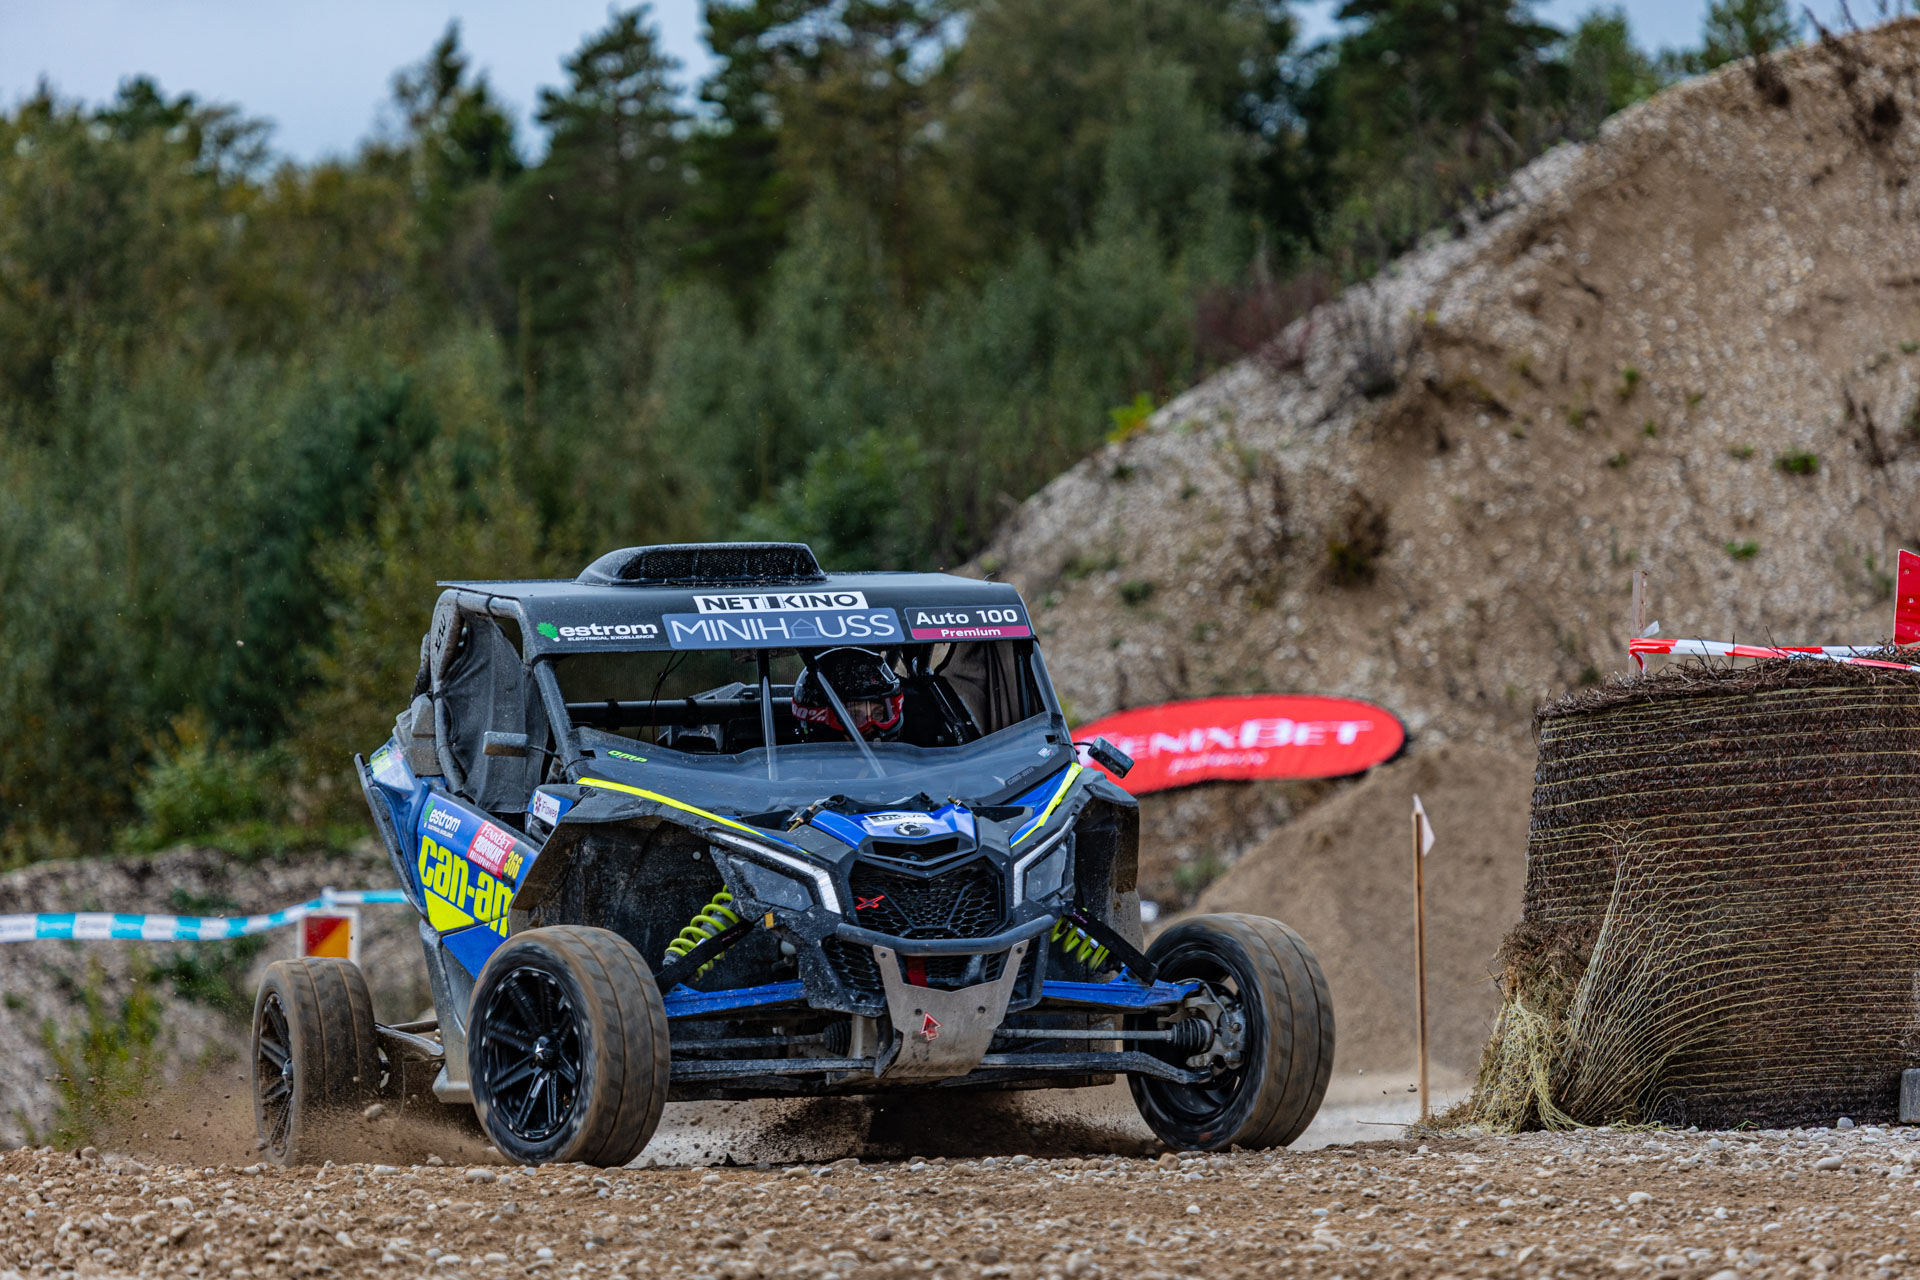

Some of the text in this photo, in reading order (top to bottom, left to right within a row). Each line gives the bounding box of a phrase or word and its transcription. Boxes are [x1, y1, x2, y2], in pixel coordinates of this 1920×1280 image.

[916, 609, 1018, 626] Auto 100
[559, 623, 658, 638] estrom
[941, 628, 1001, 638] Premium
[428, 808, 462, 833] estrom
[503, 850, 523, 879] 366
